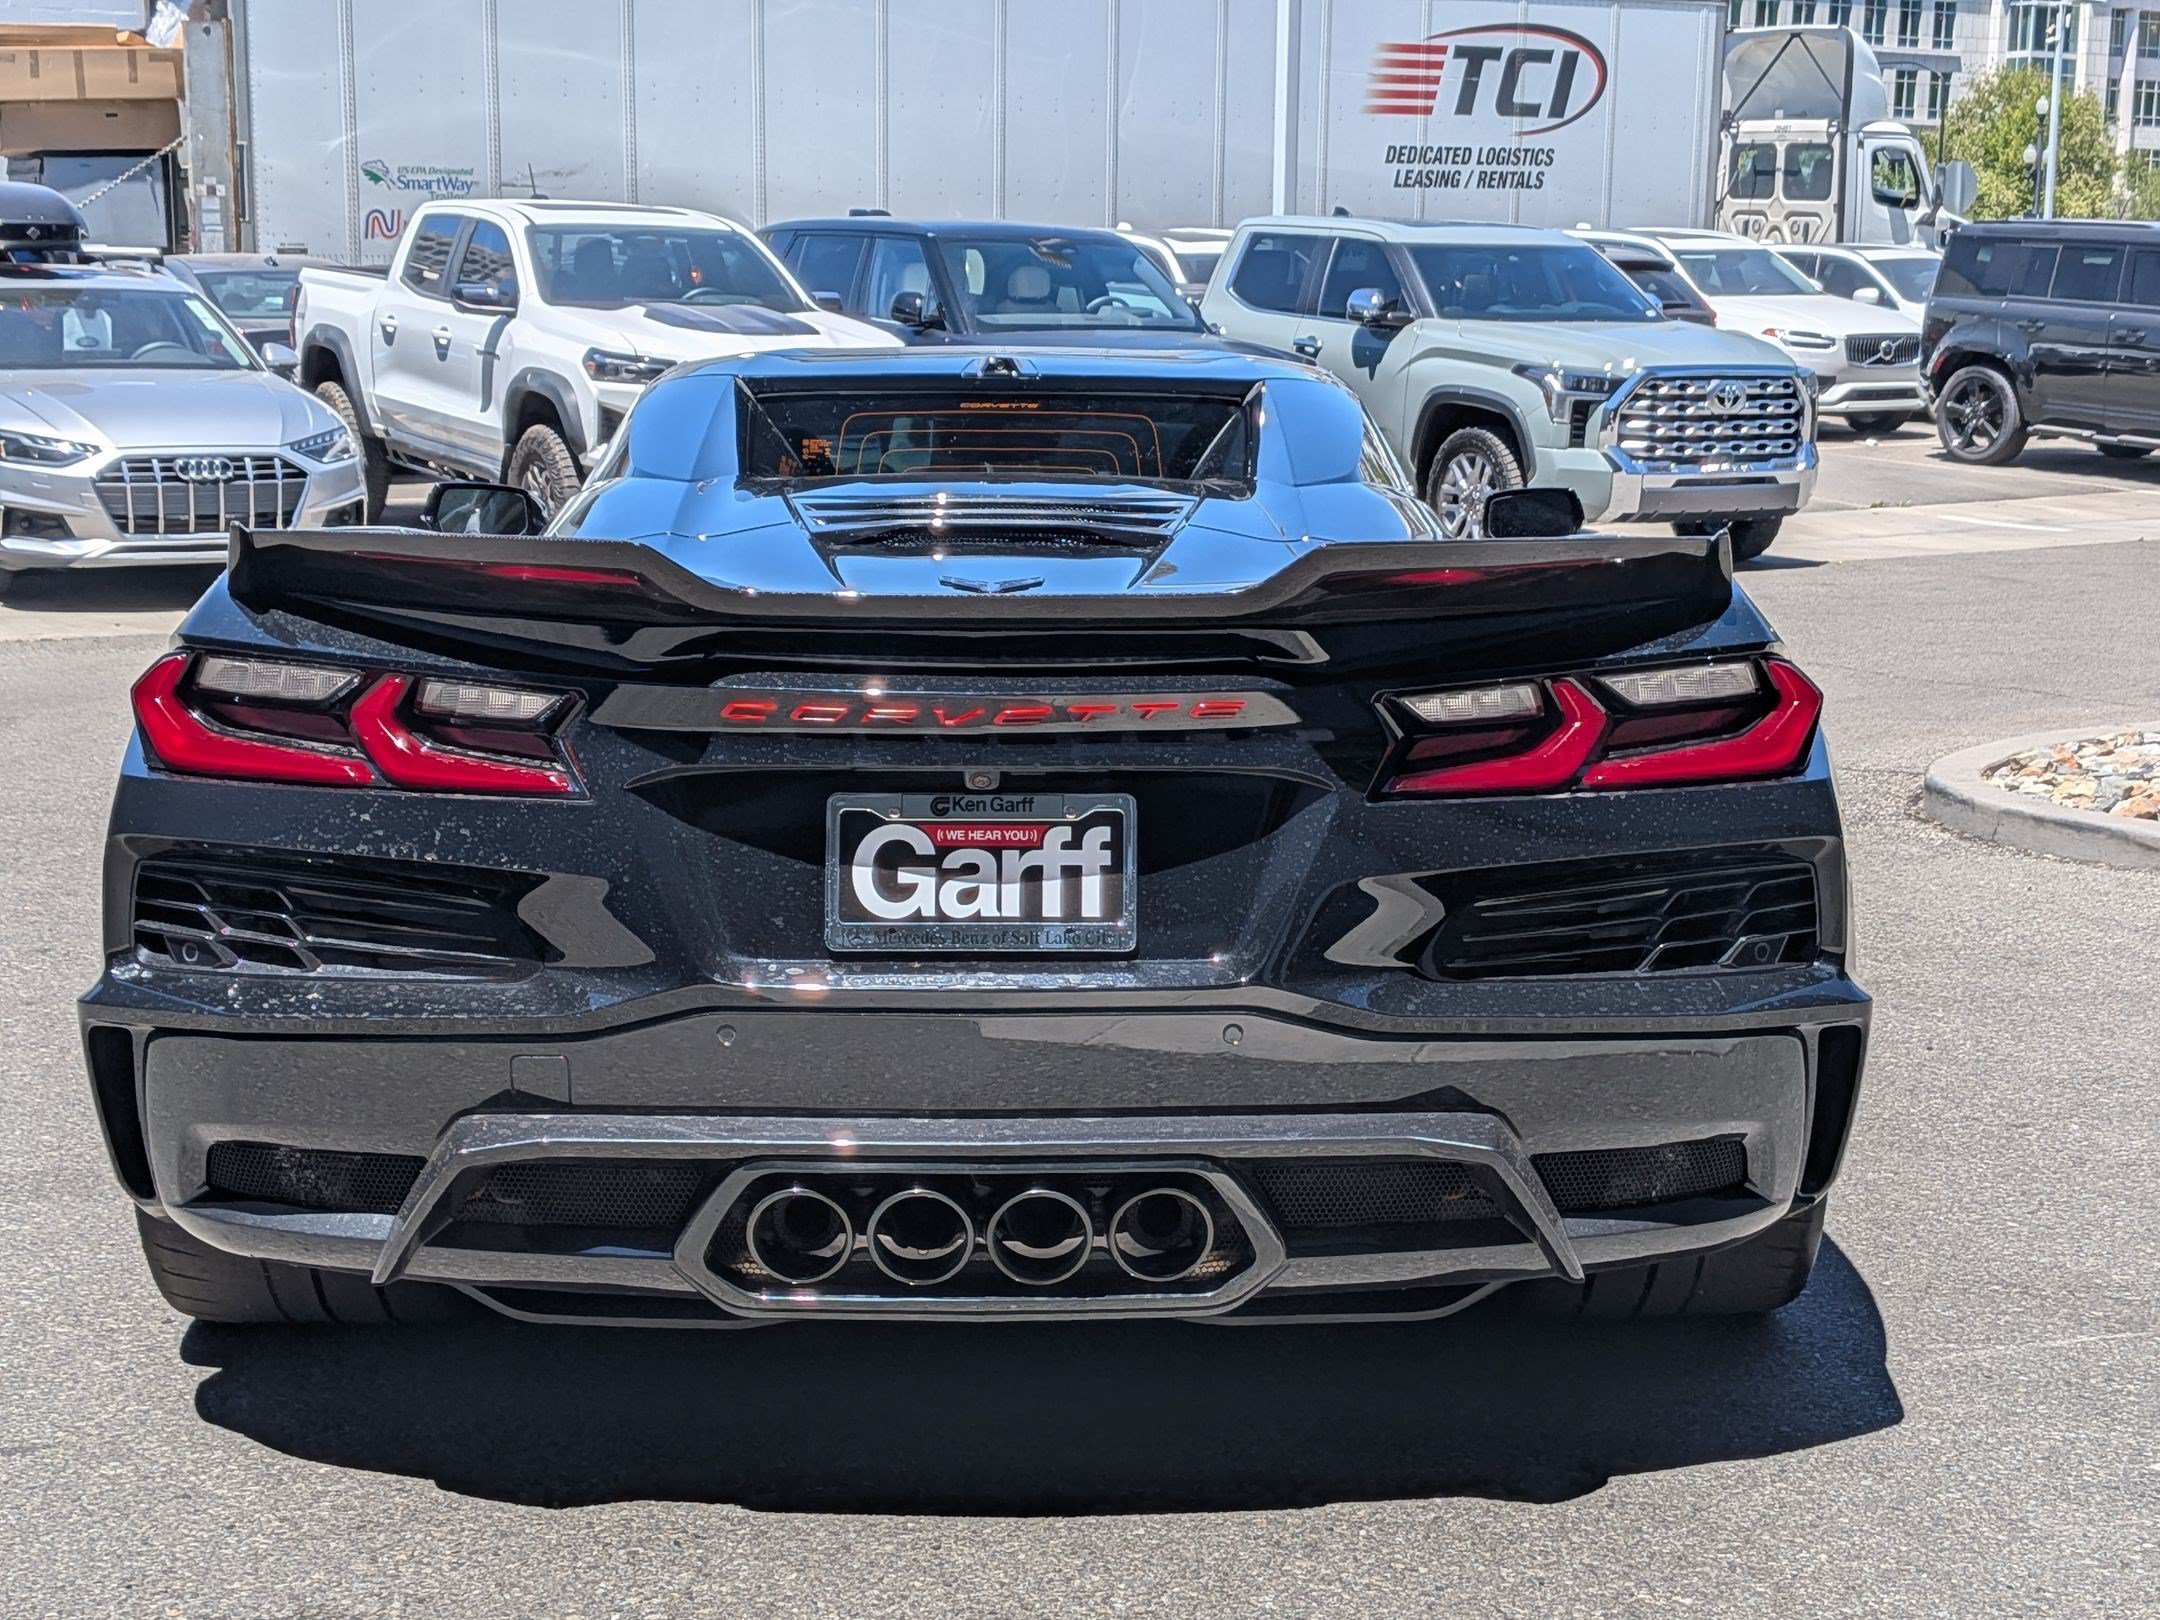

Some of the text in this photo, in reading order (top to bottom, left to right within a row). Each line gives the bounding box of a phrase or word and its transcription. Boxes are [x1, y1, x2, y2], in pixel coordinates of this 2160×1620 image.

[1453, 45, 1580, 118] TCI
[1385, 145, 1555, 167] DEDICATED LOGISTICS
[410, 166, 427, 175] EPA
[428, 166, 474, 176] Designated
[1394, 169, 1461, 189] LEASING
[1476, 170, 1545, 190] RENTALS
[720, 702, 1246, 725] CORVETTE
[952, 796, 1034, 812] Ken Garff
[946, 830, 1028, 840] WE HEAR YOU
[852, 824, 1112, 919] Garff
[994, 931, 1008, 945] of
